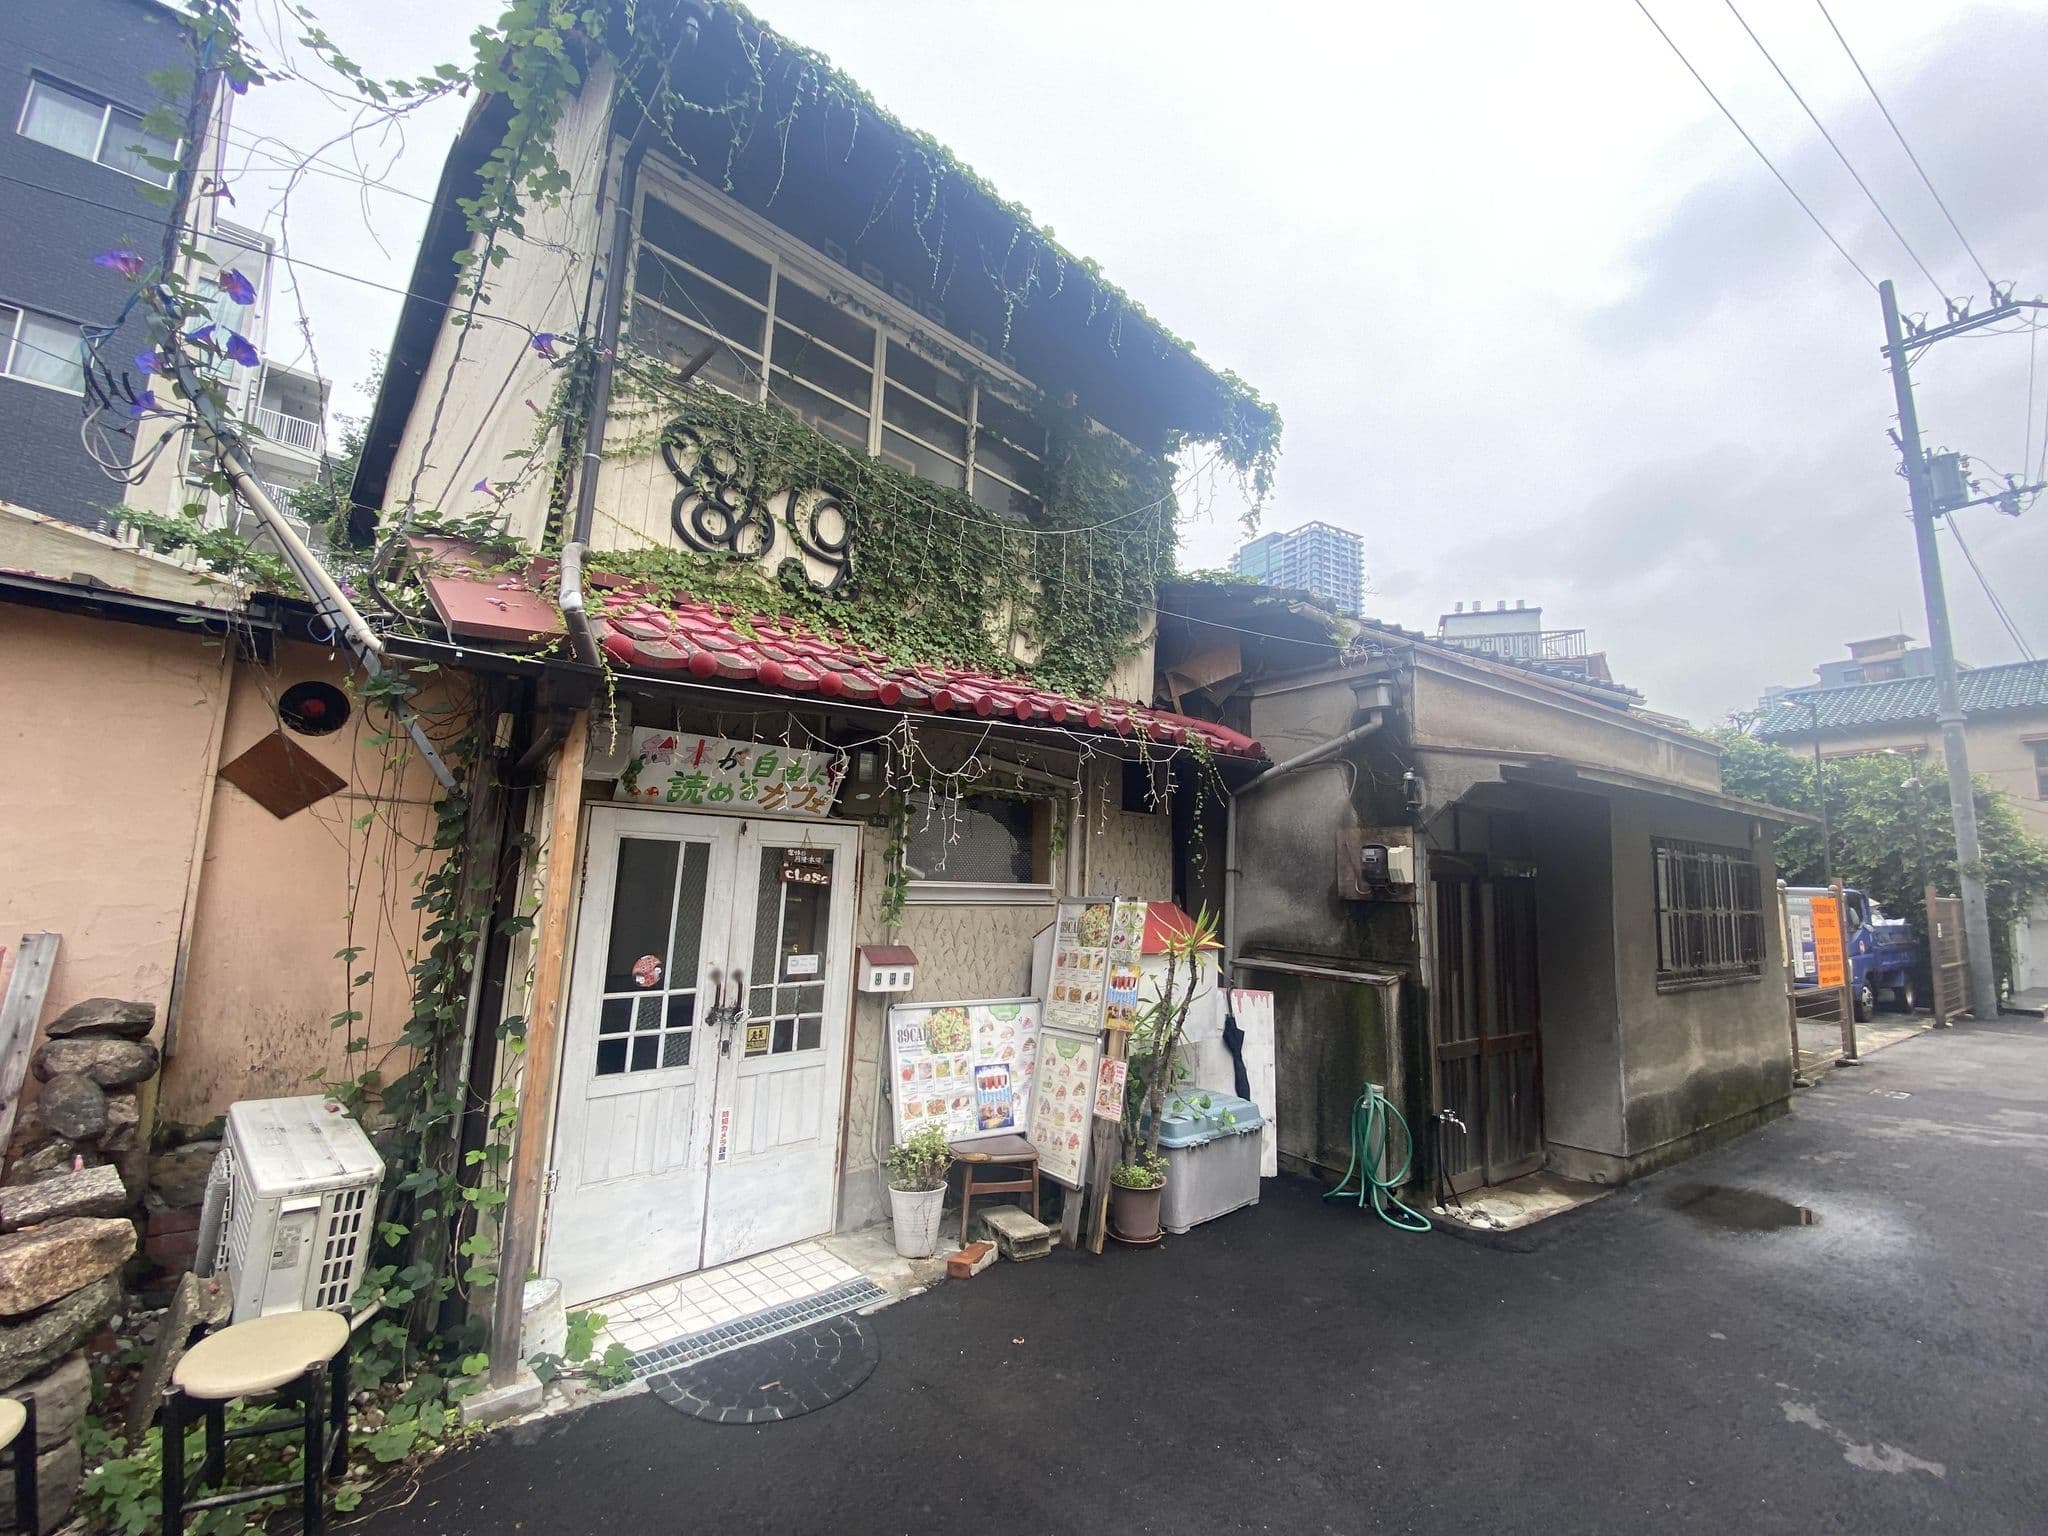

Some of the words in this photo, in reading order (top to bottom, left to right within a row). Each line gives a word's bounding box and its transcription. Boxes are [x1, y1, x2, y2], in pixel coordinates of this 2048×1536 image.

[666, 770, 827, 814] 読めるカフェ
